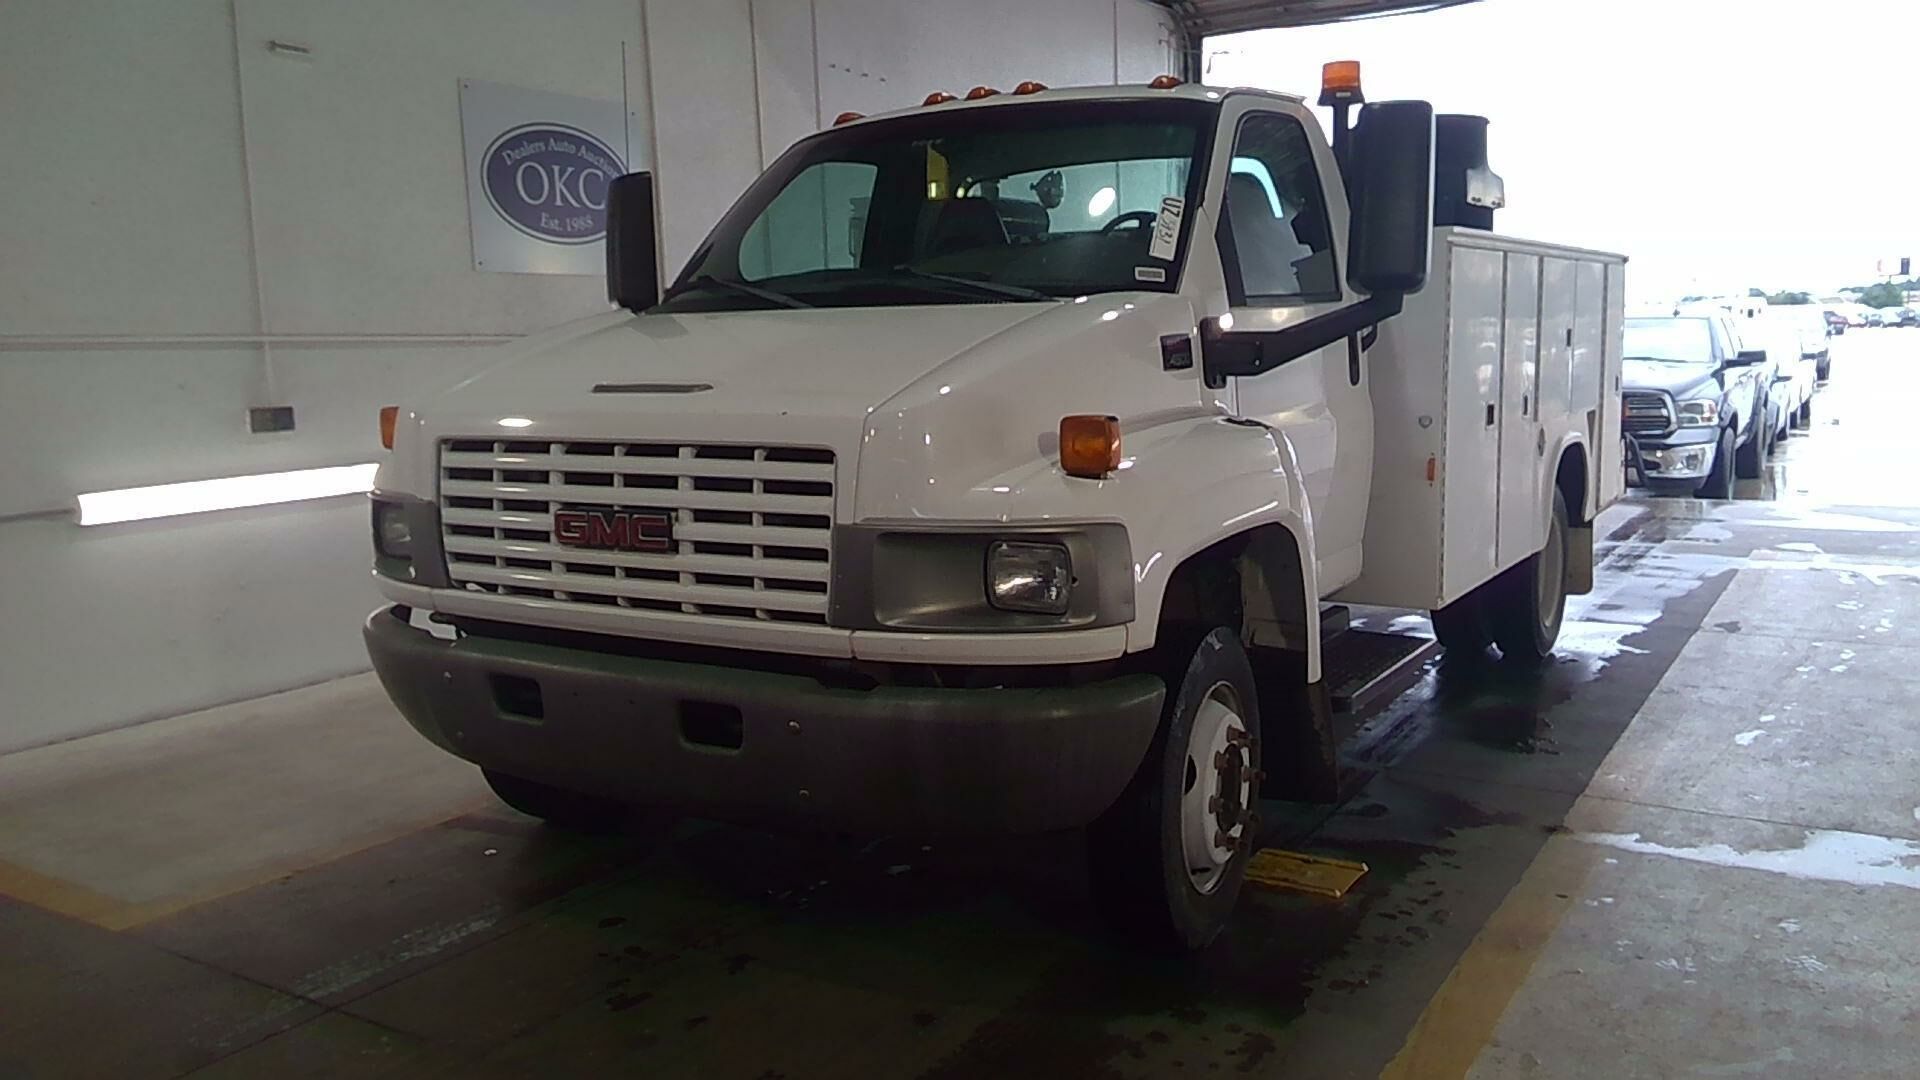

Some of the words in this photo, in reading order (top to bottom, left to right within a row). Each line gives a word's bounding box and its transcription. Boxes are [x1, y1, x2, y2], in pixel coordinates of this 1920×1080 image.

[502, 140, 546, 165] Dealers
[548, 138, 577, 154] Auto
[516, 161, 605, 210] OKC
[541, 212, 563, 231] Est.
[555, 510, 669, 548] GMC
